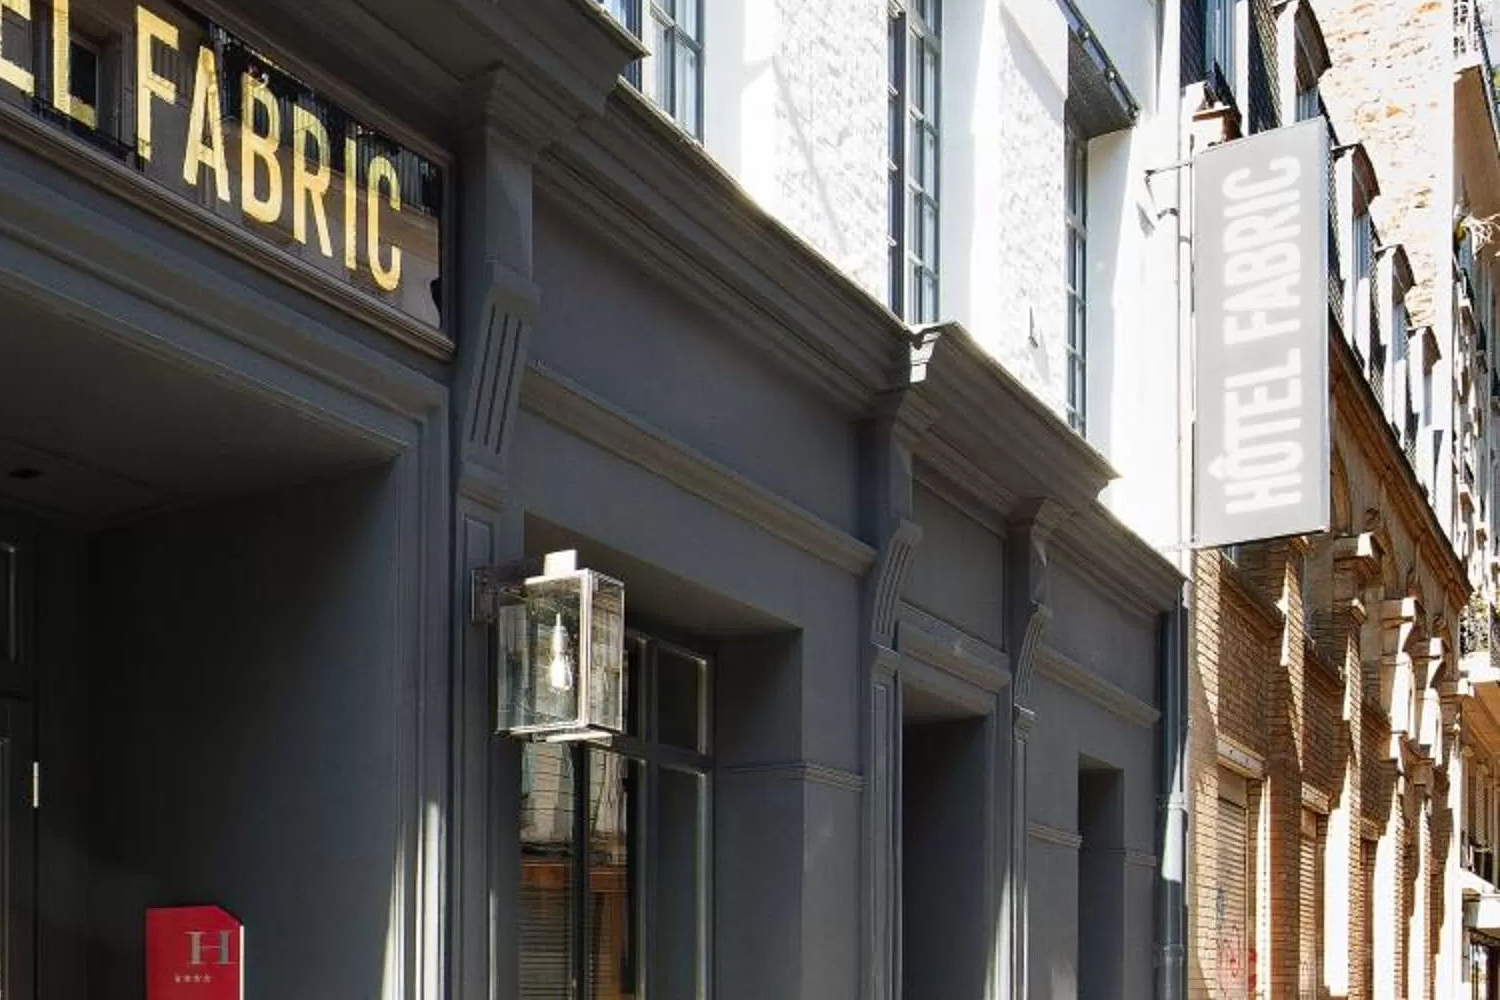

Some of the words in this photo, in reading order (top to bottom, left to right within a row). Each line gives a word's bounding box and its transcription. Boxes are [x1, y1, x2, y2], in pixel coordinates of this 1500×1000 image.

[136, 4, 403, 293] FABRIC
[1222, 154, 1301, 346] FABRIC
[1208, 348, 1302, 515] HÔTEL
[185, 930, 237, 966] H
